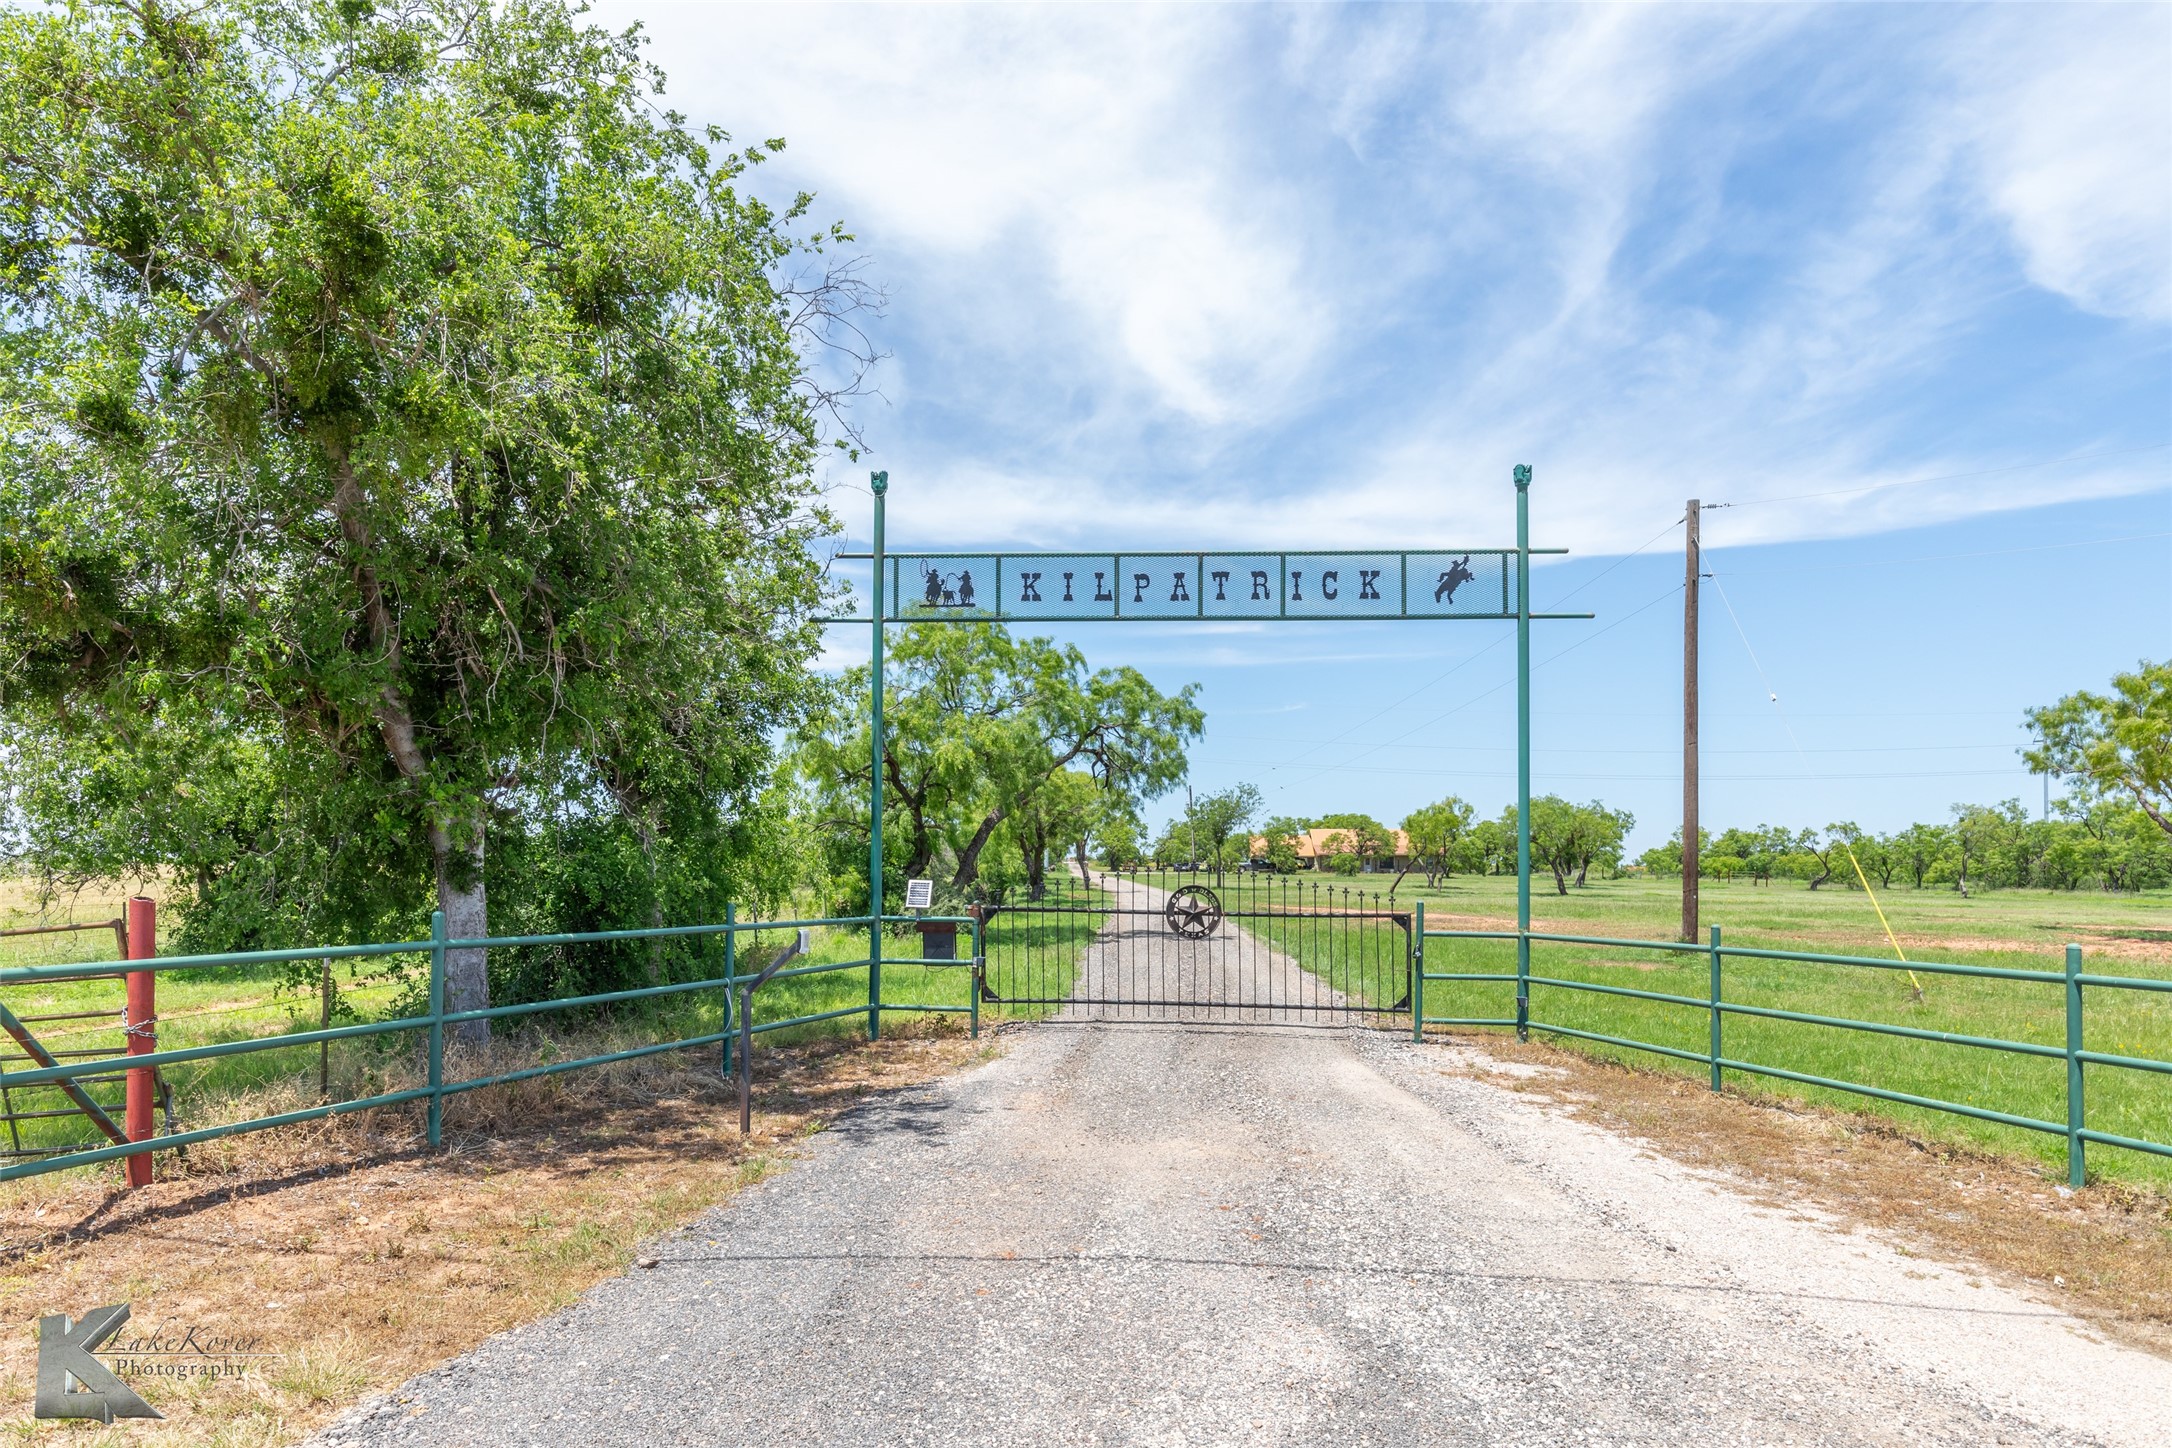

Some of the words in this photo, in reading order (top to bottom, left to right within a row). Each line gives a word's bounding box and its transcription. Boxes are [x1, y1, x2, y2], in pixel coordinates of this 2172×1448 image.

[1020, 570, 1381, 603] KILPATRICK
[1171, 888, 1188, 904] GOD
[1178, 928, 1210, 938] TEXAS
